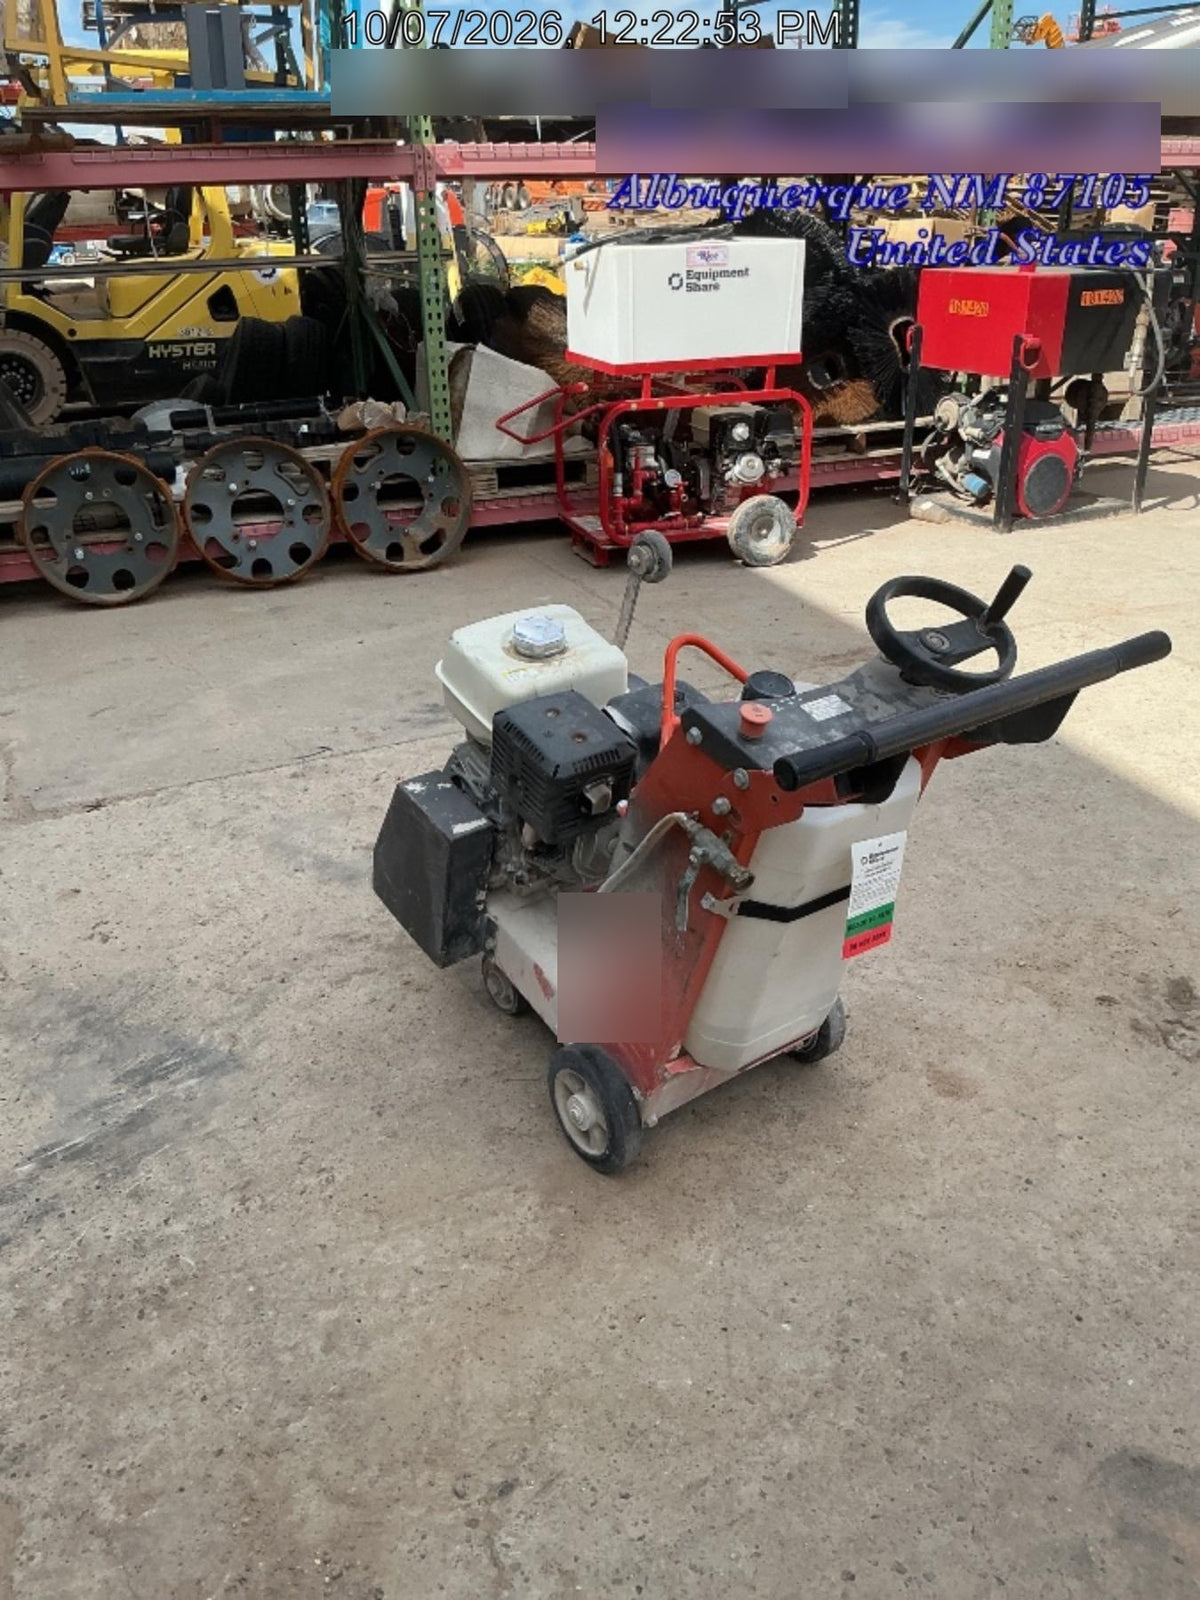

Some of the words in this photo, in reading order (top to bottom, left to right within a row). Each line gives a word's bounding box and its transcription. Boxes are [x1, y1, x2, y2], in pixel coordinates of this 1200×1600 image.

[685, 267, 750, 282] Equipment
[685, 282, 721, 293] Share
[148, 342, 217, 359] HYSTER
